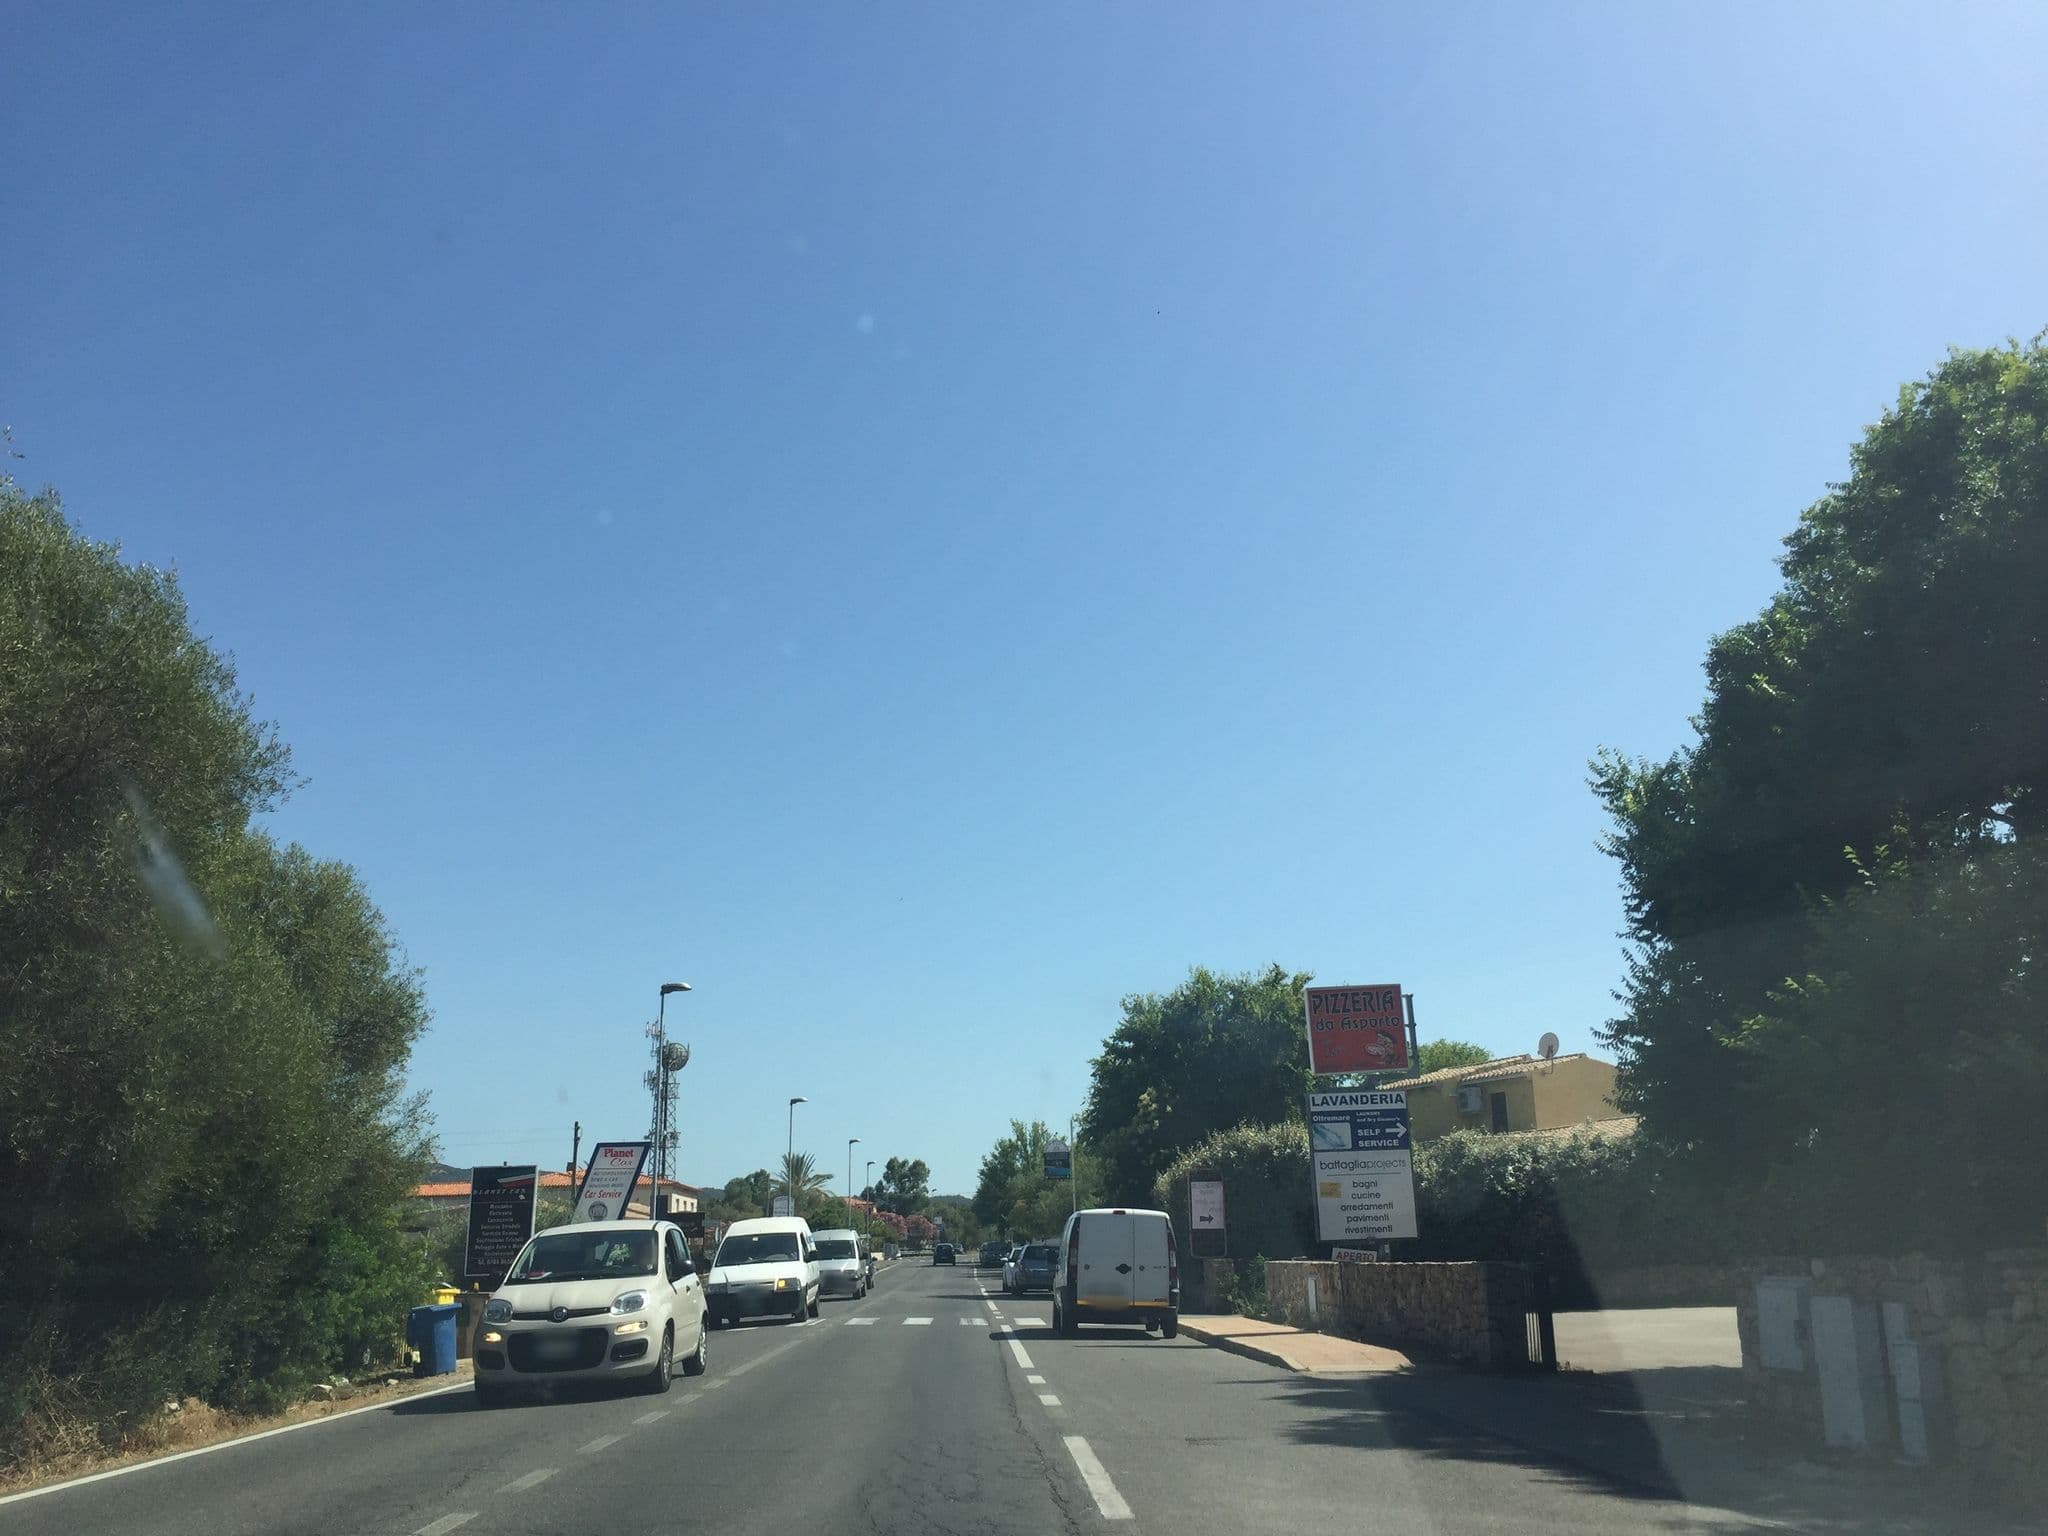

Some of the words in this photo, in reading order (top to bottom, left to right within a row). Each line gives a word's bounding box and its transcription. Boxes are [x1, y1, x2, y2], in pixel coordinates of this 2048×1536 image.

[1311, 991, 1394, 1013] PIZZERIA
[1316, 1018, 1334, 1031] da
[1341, 1015, 1400, 1033] Asporto
[1311, 1094, 1404, 1106] LAVANDERIA
[1357, 1129, 1380, 1137] SELF
[1358, 1139, 1400, 1148] SERVICE
[604, 1148, 635, 1158] Planet
[610, 1158, 633, 1167] Car
[1320, 1160, 1406, 1171] battagliaprojects
[1352, 1180, 1378, 1190] bagni
[584, 1190, 597, 1199] Car
[597, 1189, 623, 1199] Service
[1351, 1192, 1381, 1200] cucine
[1340, 1202, 1394, 1212] arredamenti
[1346, 1214, 1390, 1224] pavimenti
[1344, 1225, 1393, 1235] rivestimenti
[1336, 1252, 1375, 1261] APERTO
